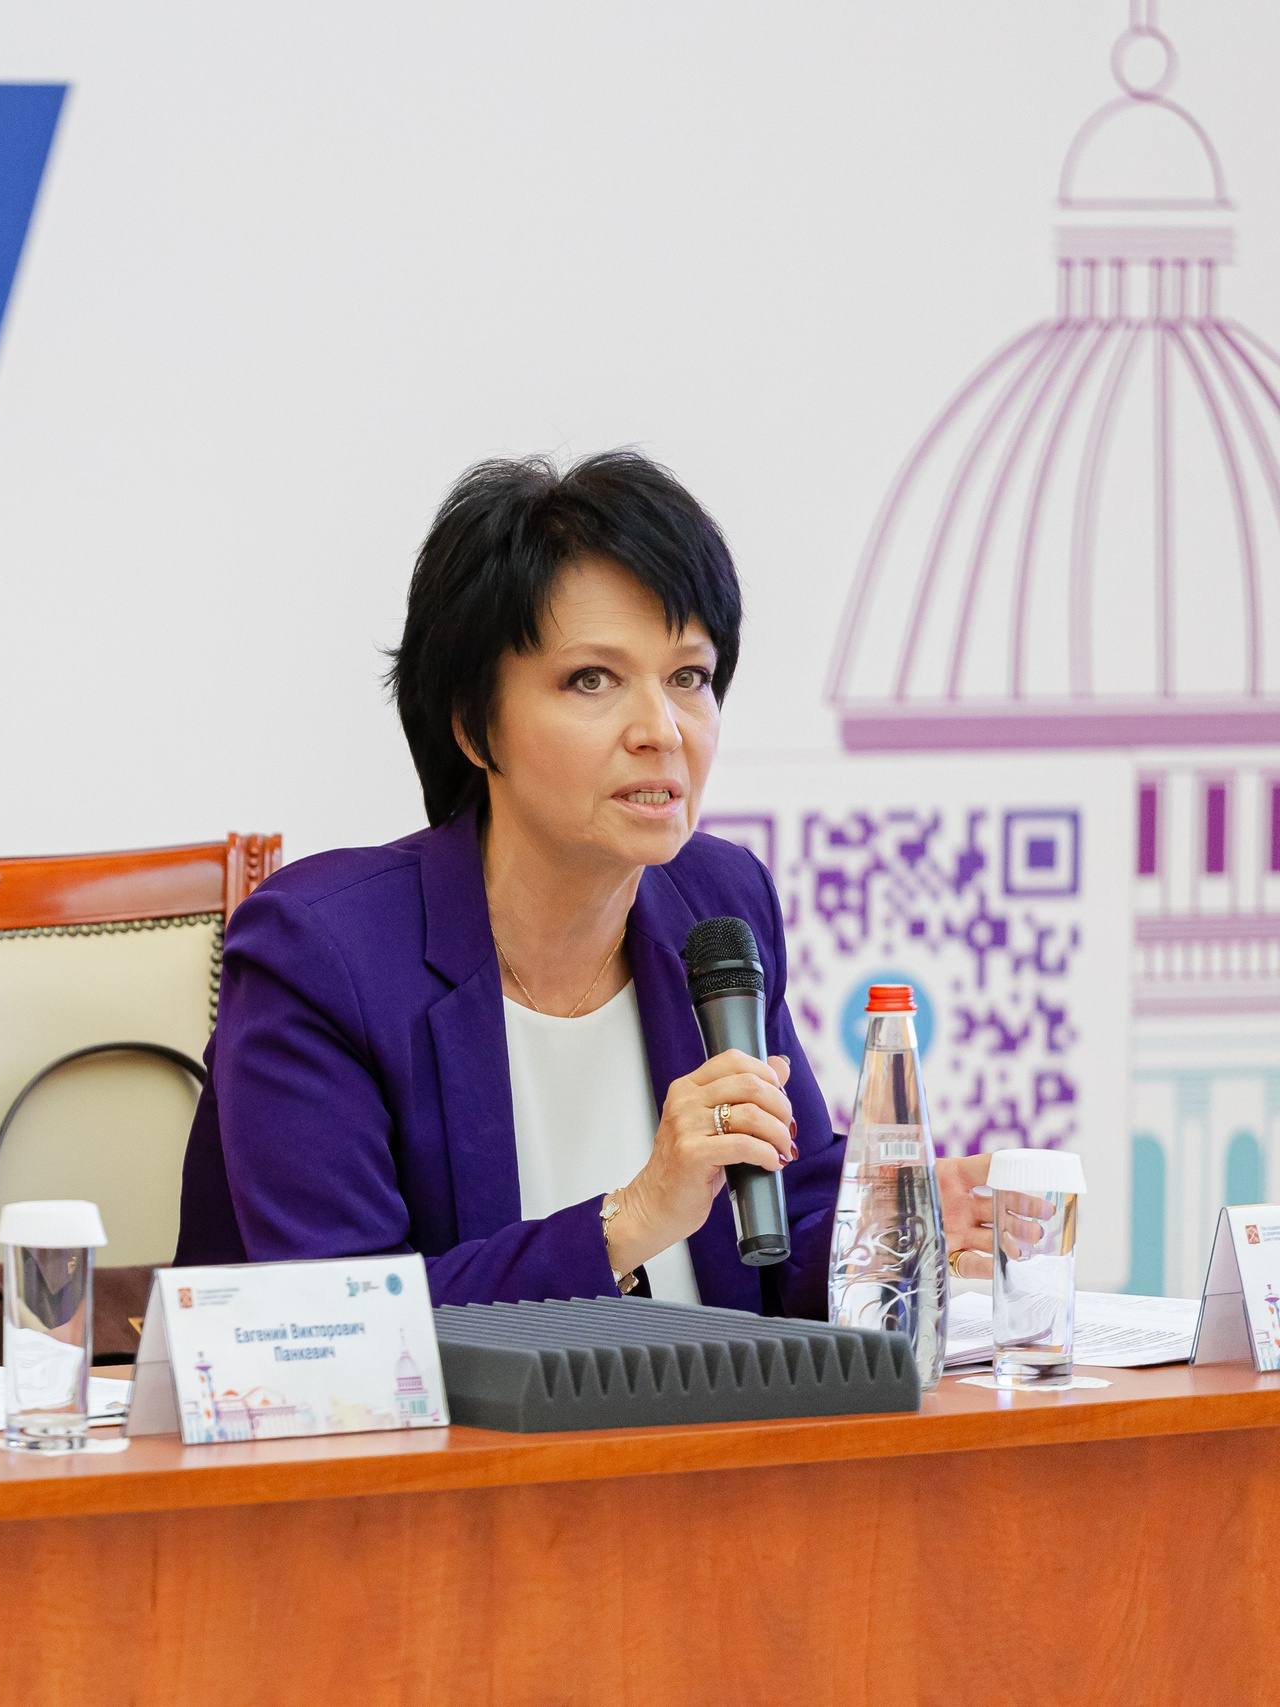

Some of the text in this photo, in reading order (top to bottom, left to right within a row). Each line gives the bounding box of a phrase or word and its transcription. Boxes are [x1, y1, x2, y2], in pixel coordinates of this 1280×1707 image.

[234, 1322, 366, 1344] Евгений Викторович
[274, 1345, 336, 1362] Панкевич
